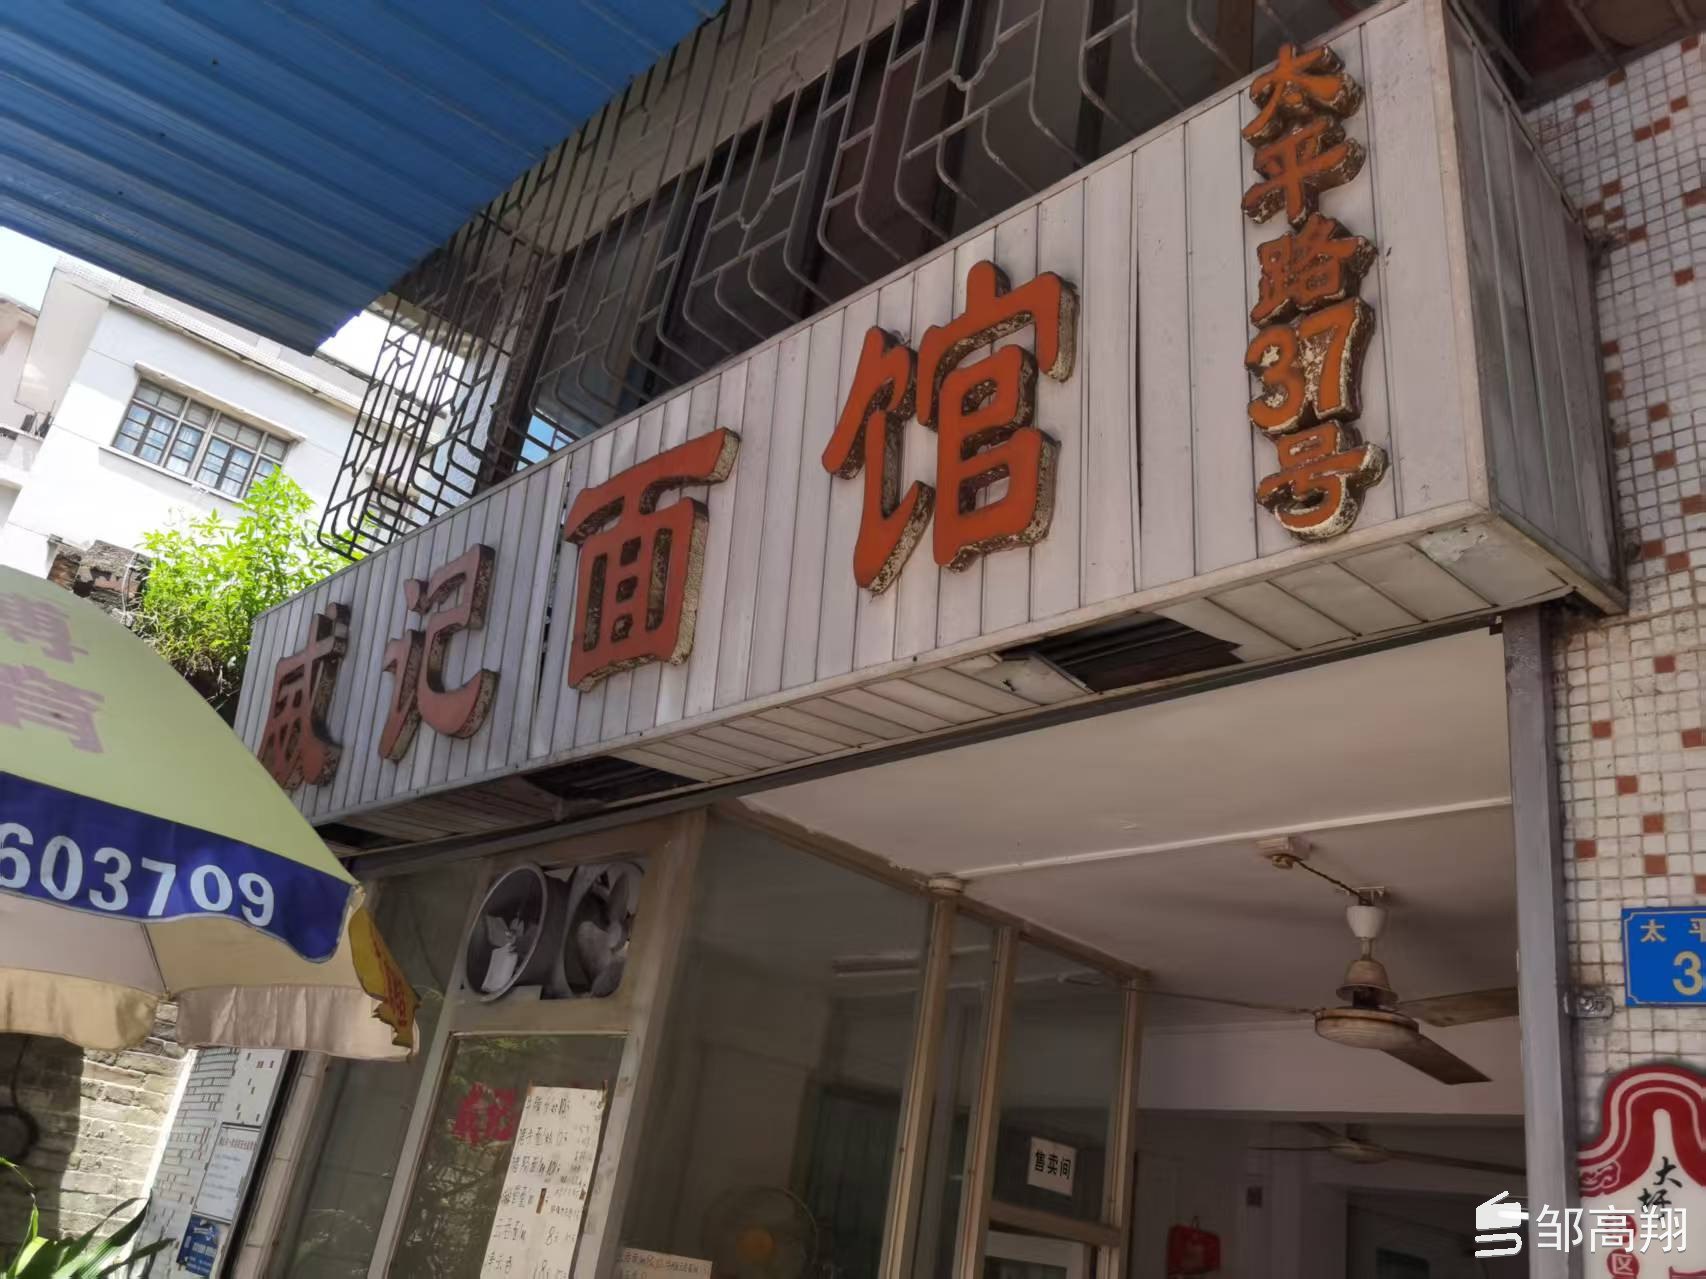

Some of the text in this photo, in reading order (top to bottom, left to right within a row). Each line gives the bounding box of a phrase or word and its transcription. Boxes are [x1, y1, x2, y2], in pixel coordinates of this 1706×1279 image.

[1241, 43, 1388, 541] 太平路37号
[0, 823, 275, 927] 603709
[1035, 1151, 1071, 1180] 售卖间
